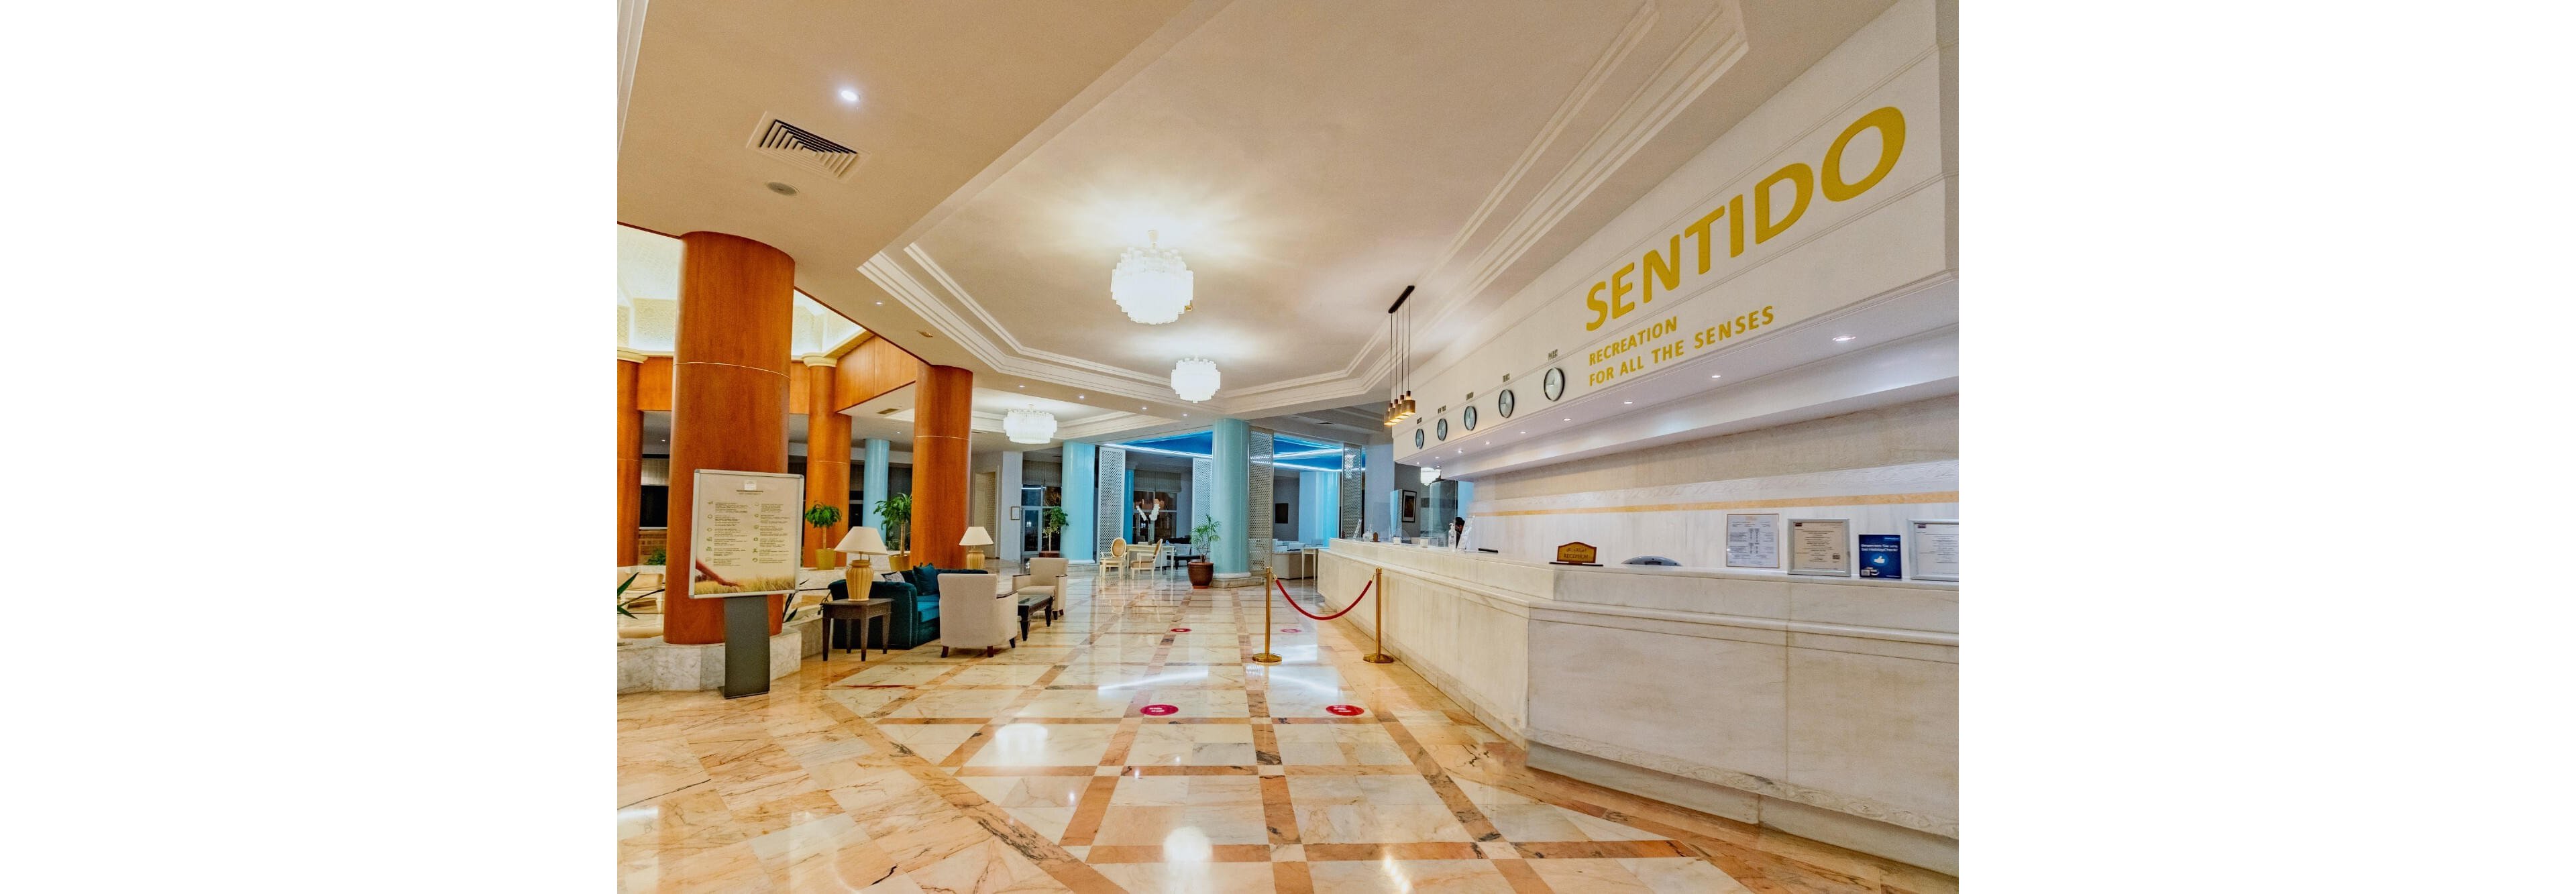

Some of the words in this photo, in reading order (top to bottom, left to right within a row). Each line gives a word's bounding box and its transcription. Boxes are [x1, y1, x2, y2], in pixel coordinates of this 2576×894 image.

[1586, 107, 1907, 332] SENTIDO
[1589, 316, 1677, 366] RECREATION
[1589, 366, 1615, 387] FOR
[1619, 356, 1644, 376] ALL
[1652, 340, 1684, 364] THE
[1695, 306, 1774, 349] SENSES
